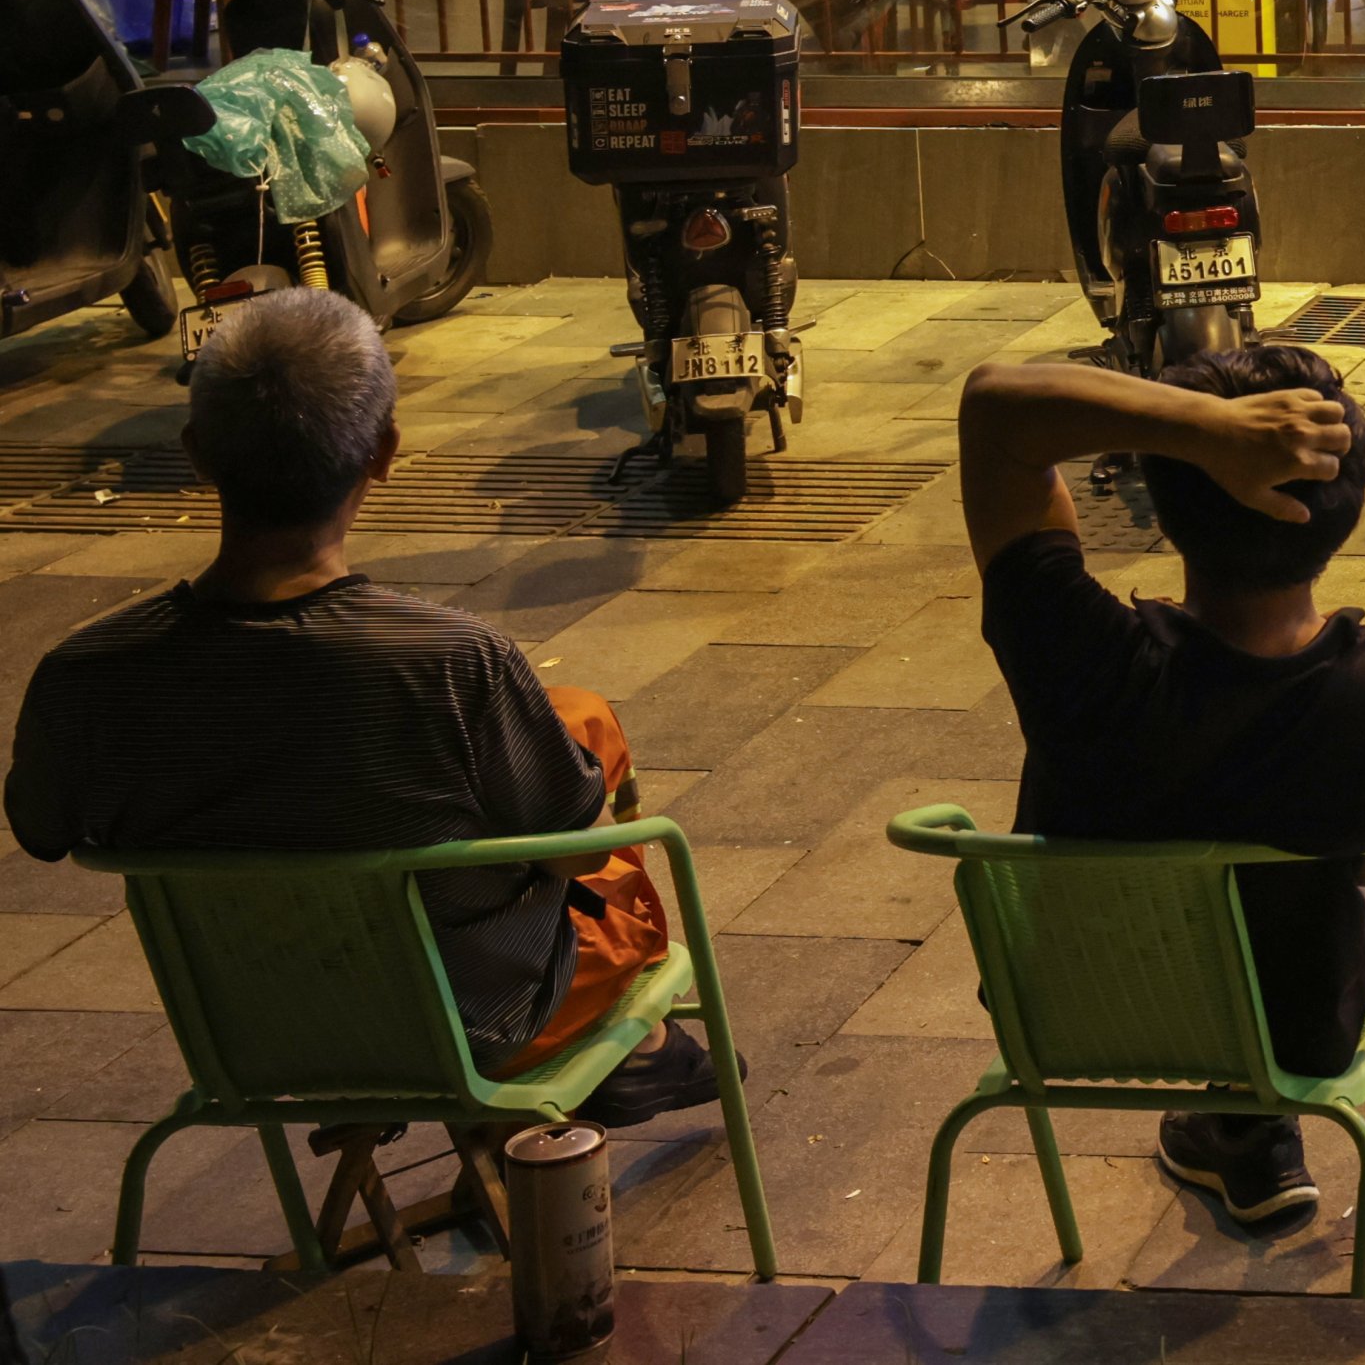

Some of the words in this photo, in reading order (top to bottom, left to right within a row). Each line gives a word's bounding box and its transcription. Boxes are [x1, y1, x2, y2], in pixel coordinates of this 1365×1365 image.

[607, 87, 631, 102] EAT
[608, 103, 647, 118] SLEEP
[609, 134, 656, 149] REPEAT
[1180, 246, 1229, 261] 北京
[1167, 256, 1247, 282] A51401
[678, 354, 759, 379] JN8112
